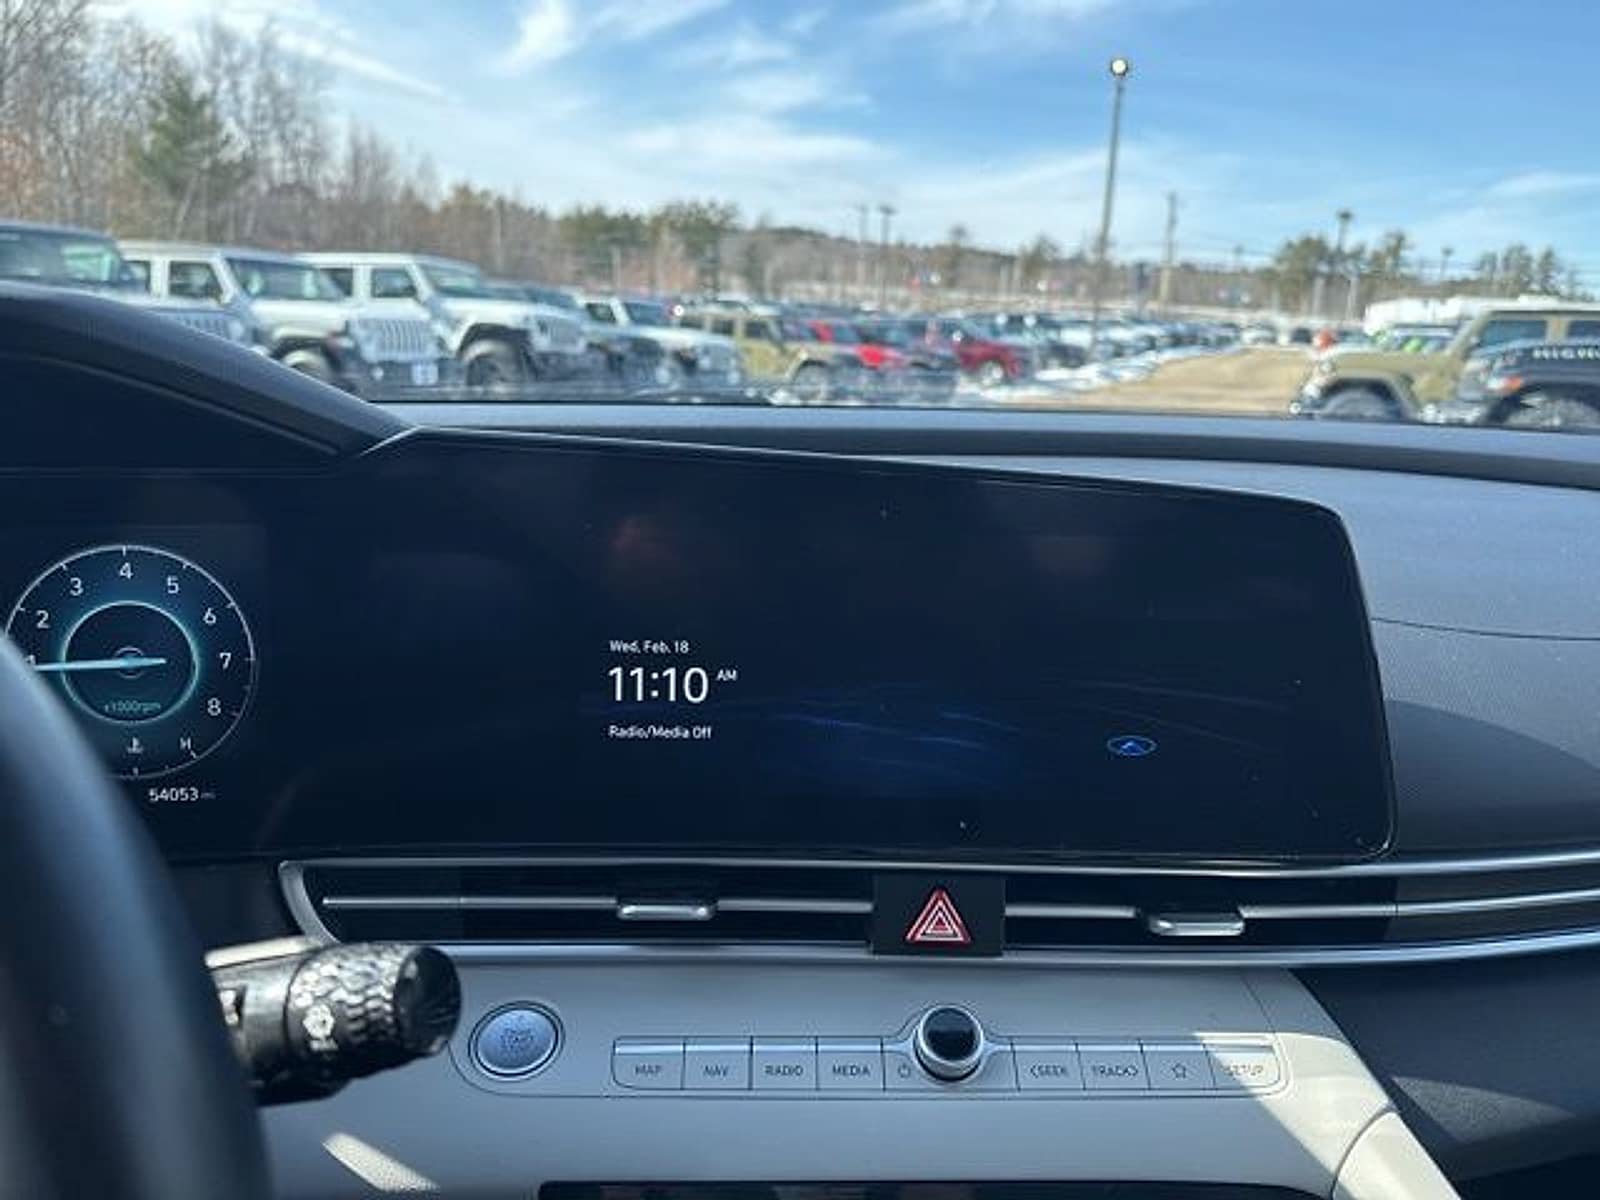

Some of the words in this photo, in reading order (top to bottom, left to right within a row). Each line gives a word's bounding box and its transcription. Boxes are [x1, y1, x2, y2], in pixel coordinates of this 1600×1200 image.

[119, 562, 132, 579] 4
[70, 578, 83, 596] 3
[166, 576, 180, 594] 5
[36, 610, 50, 629] 2
[203, 608, 217, 625] 6
[674, 640, 689, 653] 18
[219, 652, 232, 669] 7
[609, 667, 708, 703] 11:10
[716, 669, 737, 681] AM
[207, 698, 221, 716] 8
[692, 725, 712, 740] Off
[149, 787, 199, 802] 54053
[703, 1064, 729, 1077] NAV
[764, 1064, 803, 1076] RADIO
[832, 1065, 871, 1077] MEDIA
